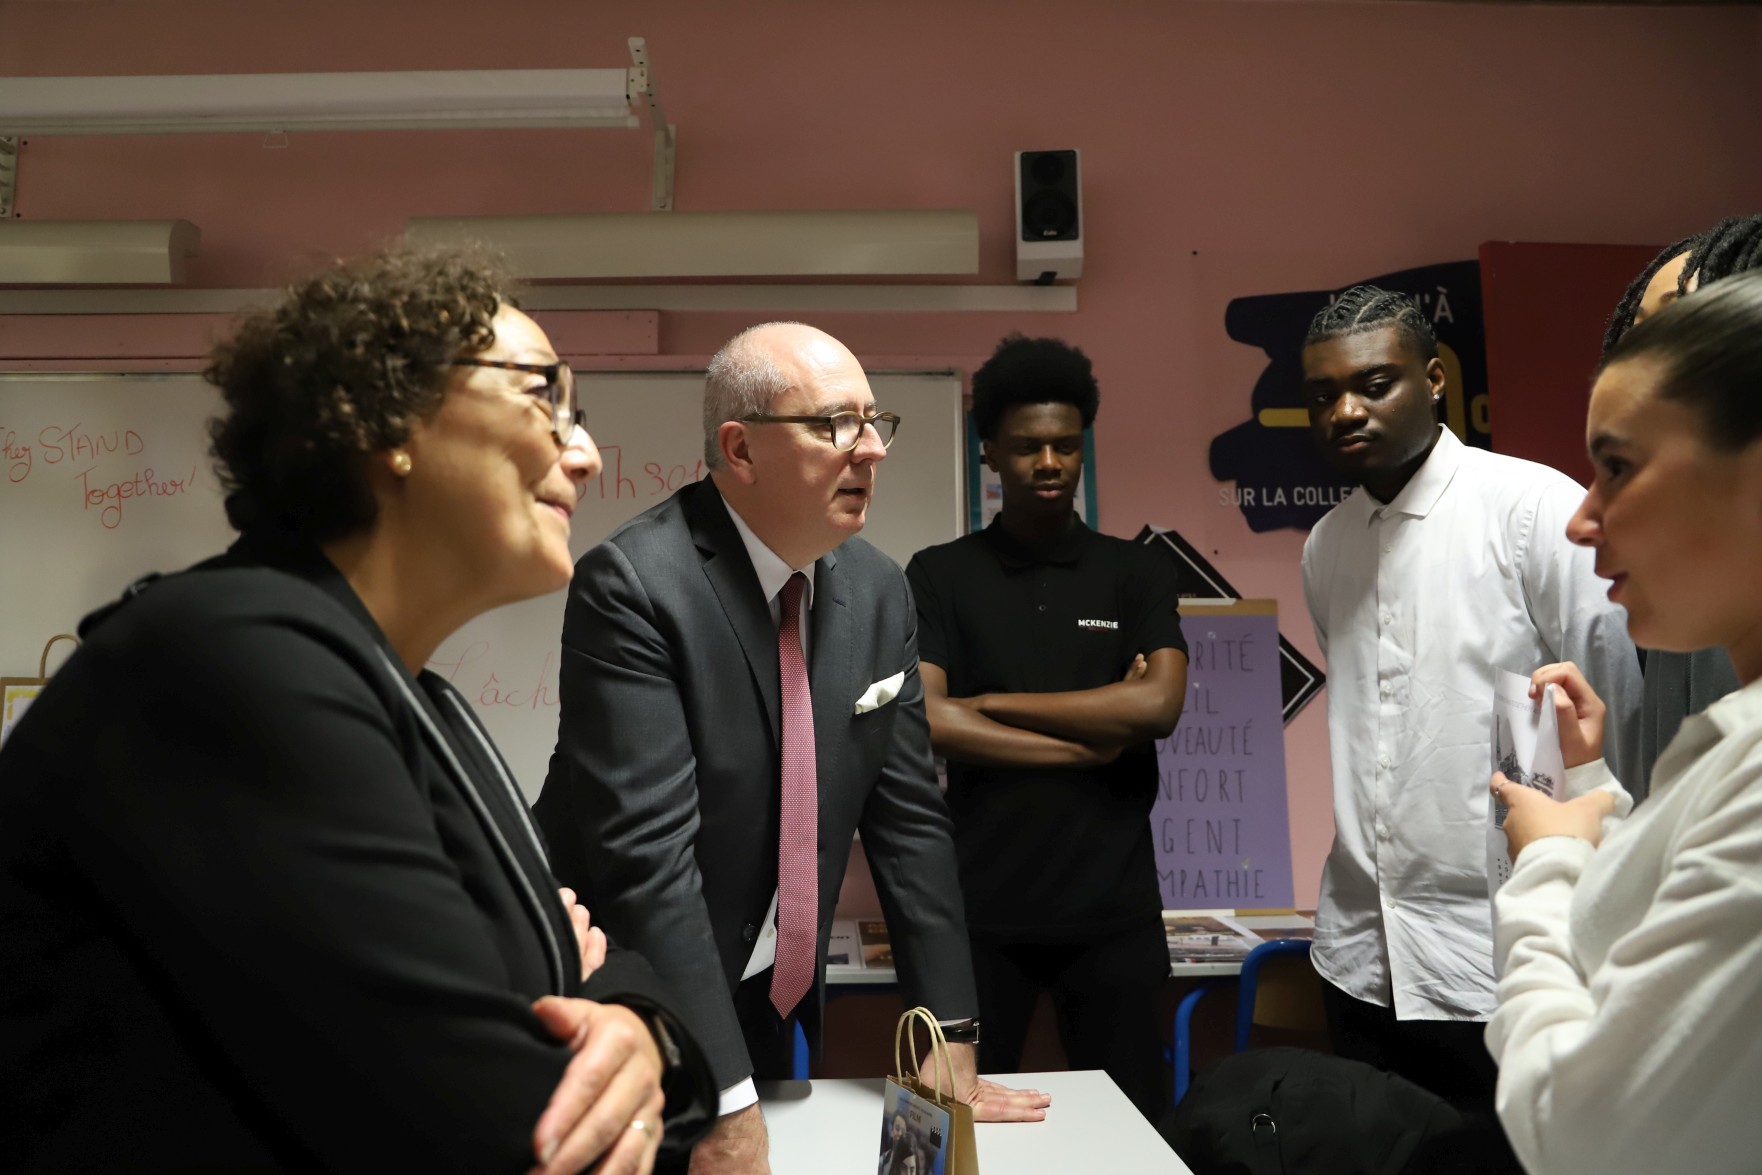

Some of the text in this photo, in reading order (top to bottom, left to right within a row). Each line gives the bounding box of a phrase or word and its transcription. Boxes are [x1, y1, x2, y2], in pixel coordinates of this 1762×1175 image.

[0, 422, 144, 483] hey STAND
[1219, 487, 1358, 506] SUR LA COLLE
[1078, 619, 1119, 629] MCKENZIE
